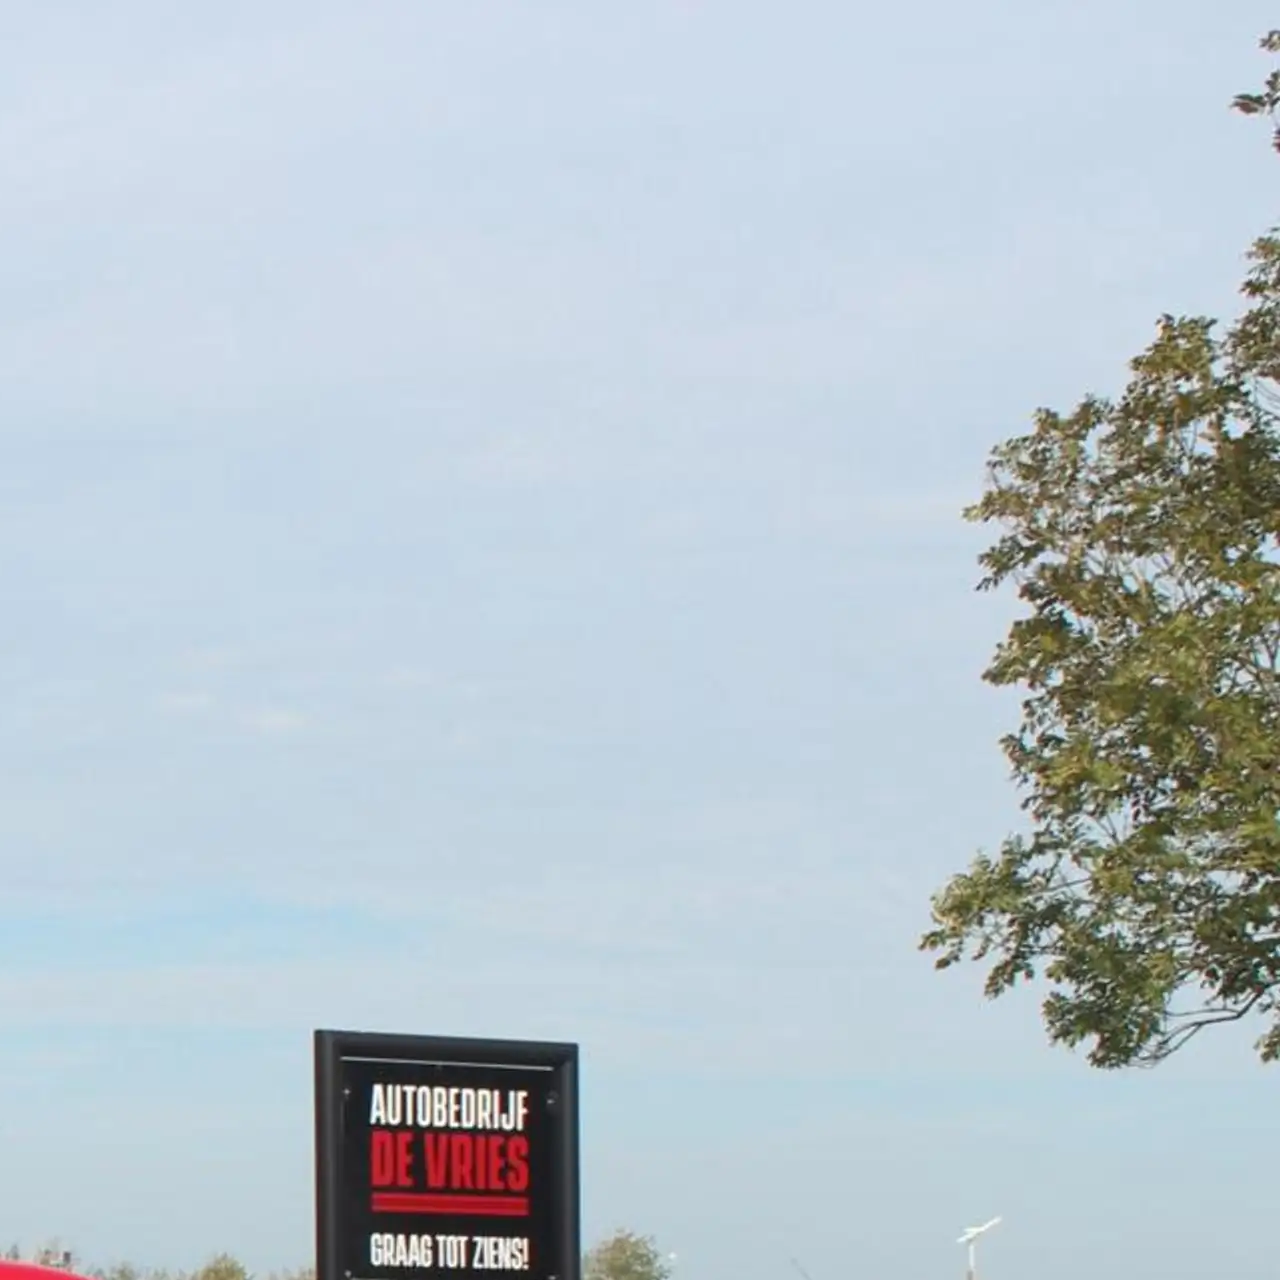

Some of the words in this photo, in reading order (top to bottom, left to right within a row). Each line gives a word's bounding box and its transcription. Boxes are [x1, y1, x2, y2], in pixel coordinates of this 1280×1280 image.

[369, 1083, 529, 1132] AUTOBEDRIJF
[370, 1130, 414, 1188] DE
[424, 1132, 530, 1191] VRIES
[369, 1232, 433, 1268] GRAAG
[435, 1234, 469, 1268] TOT
[472, 1235, 530, 1271] ZIENS!
